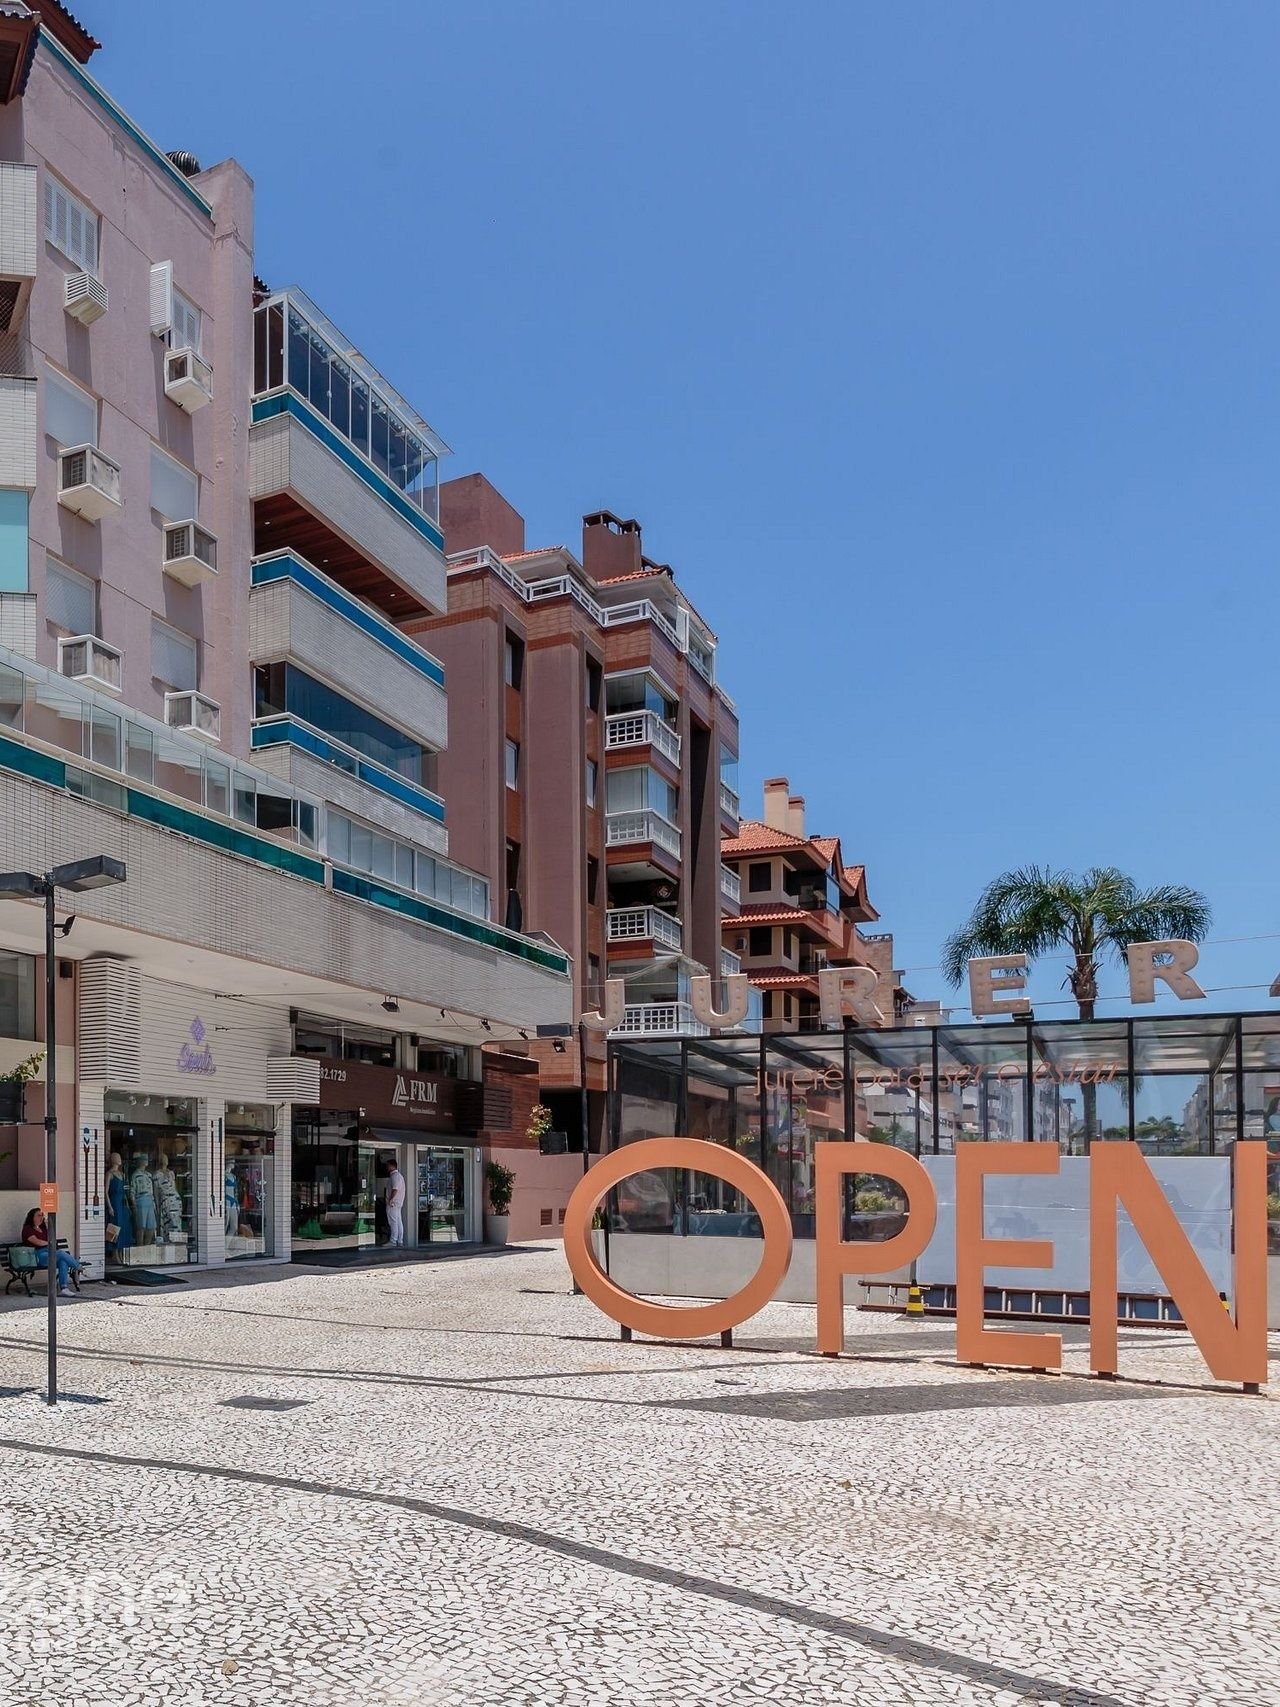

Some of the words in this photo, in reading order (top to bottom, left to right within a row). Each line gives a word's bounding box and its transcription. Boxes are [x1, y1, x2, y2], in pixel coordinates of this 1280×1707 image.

[581, 939, 1280, 1031] JURER
[410, 1080, 438, 1103] FRM
[754, 1062, 844, 1096] jurerê
[855, 1066, 924, 1091] para
[563, 1137, 1268, 1383] OPEN
